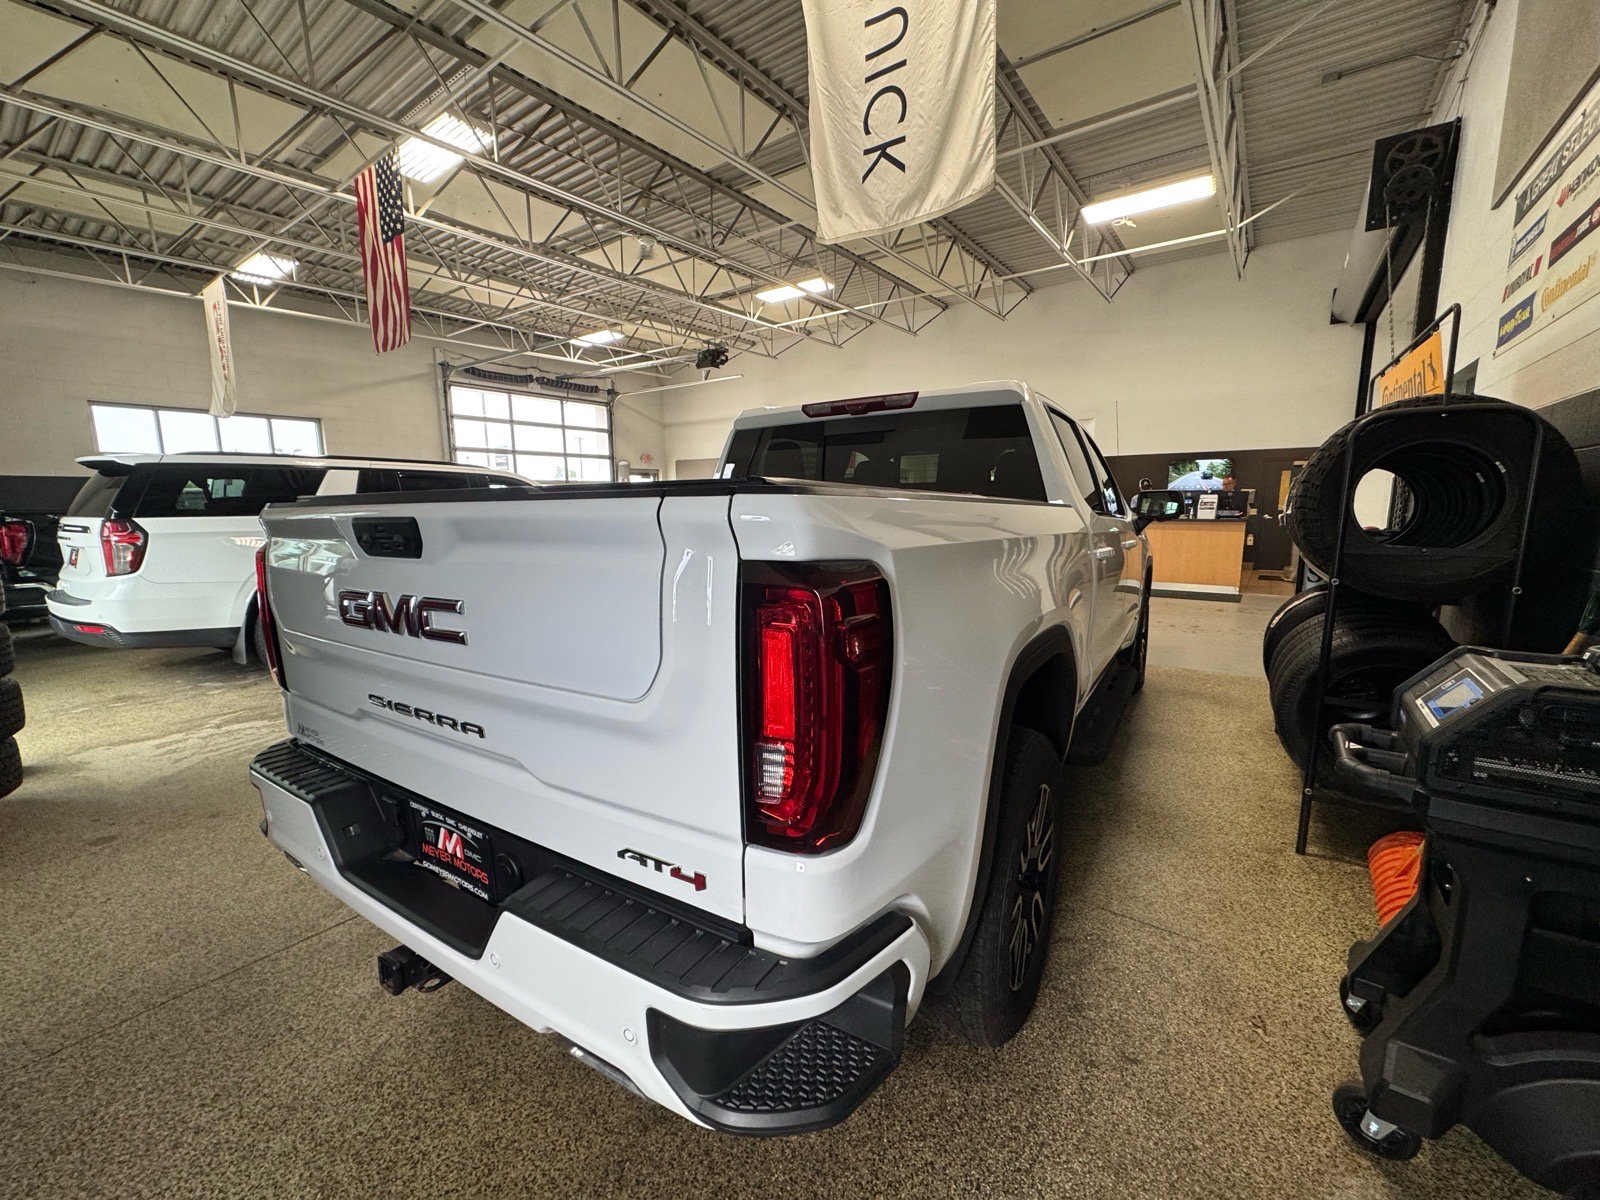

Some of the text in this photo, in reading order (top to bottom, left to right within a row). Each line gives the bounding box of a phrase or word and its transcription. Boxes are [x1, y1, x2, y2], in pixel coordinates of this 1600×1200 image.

[1560, 105, 1600, 167] SELEC
[1541, 253, 1590, 313] Continental
[1381, 358, 1427, 405] Continental
[338, 588, 469, 646] GMC
[367, 693, 487, 739] SIERRA
[422, 842, 489, 885] MEYER MOTORS
[616, 847, 707, 892] AT4
